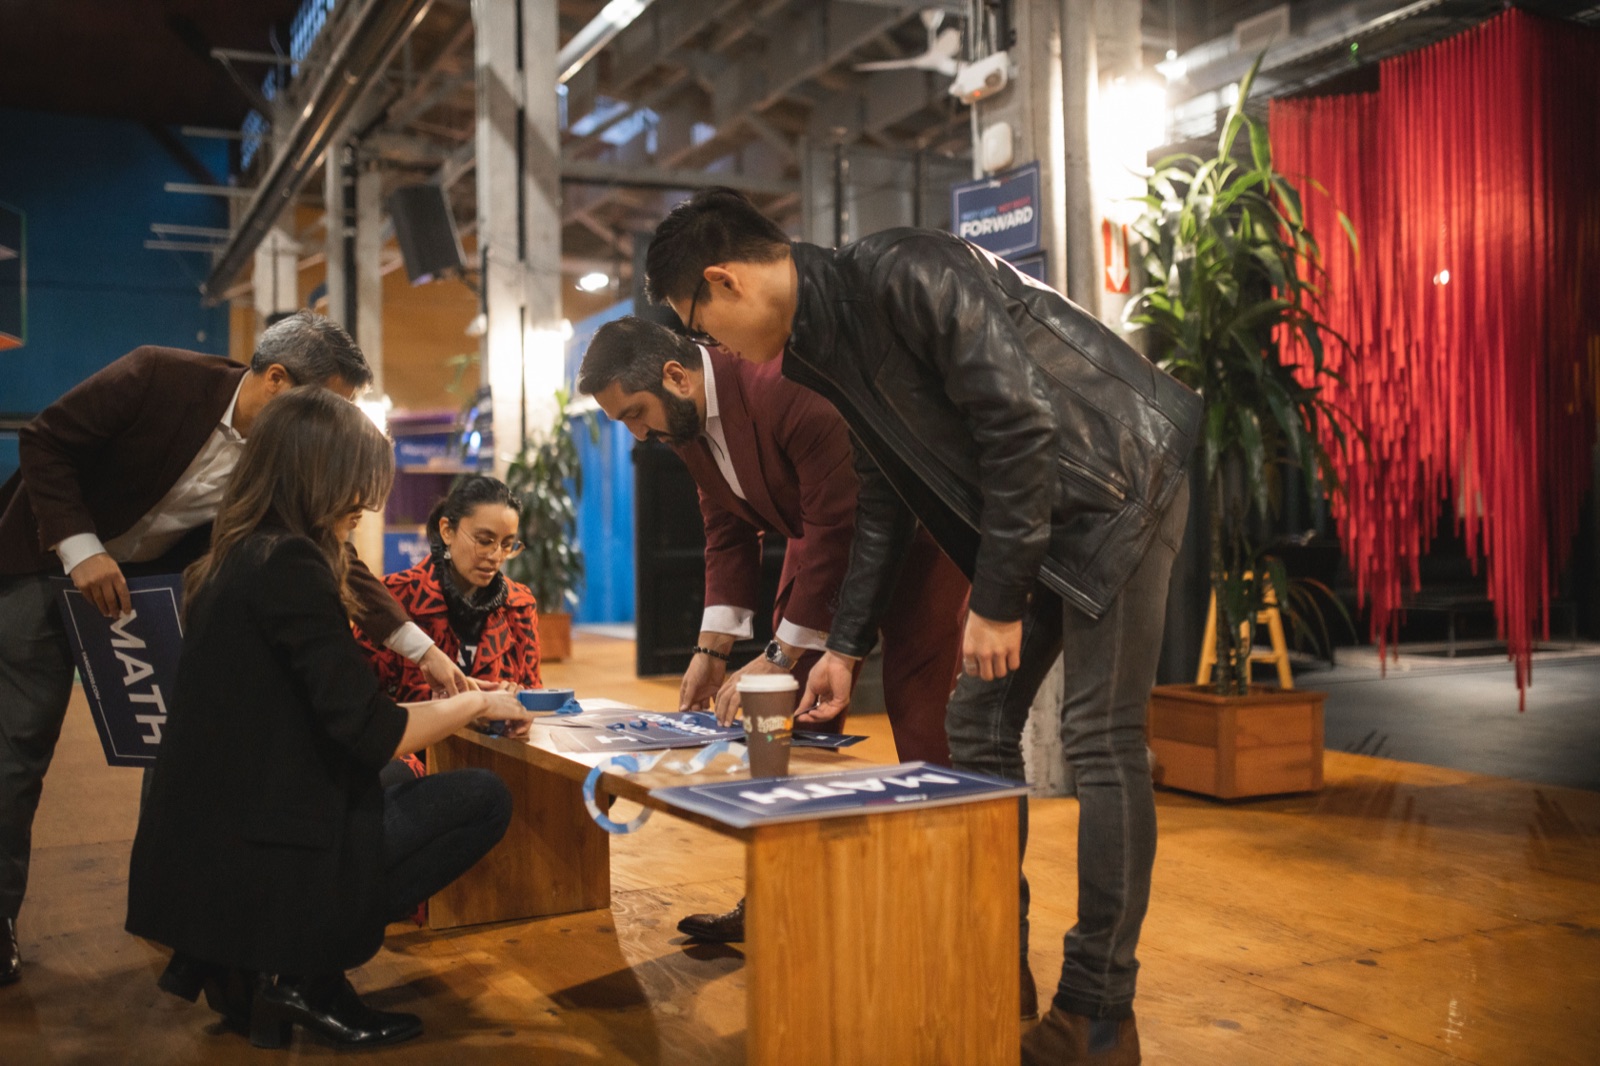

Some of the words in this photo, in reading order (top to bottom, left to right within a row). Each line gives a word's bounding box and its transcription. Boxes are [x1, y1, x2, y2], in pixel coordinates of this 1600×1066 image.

[960, 205, 1033, 238] FORWARD
[104, 609, 168, 744] MATH
[739, 773, 960, 804] MATH
